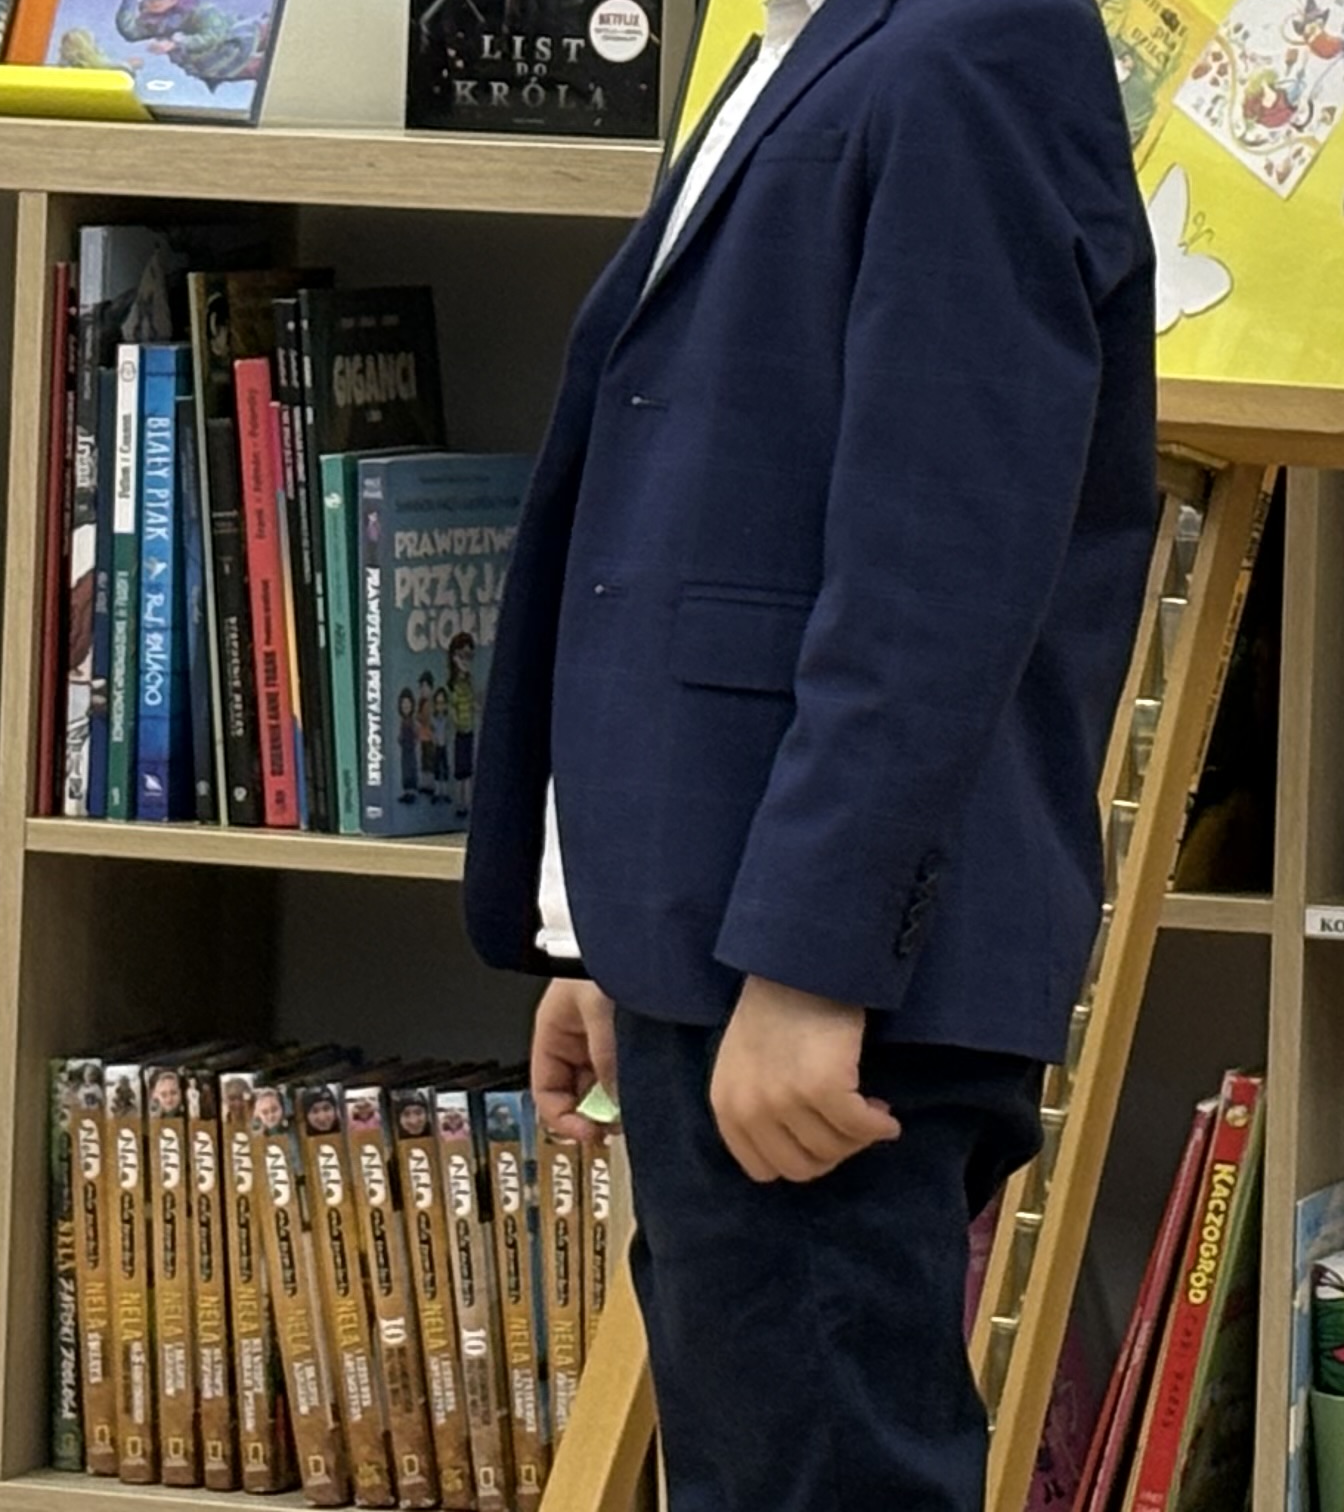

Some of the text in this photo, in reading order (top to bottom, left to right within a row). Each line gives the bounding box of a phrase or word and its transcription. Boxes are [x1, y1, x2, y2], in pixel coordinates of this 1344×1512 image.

[481, 33, 586, 65] LIST
[515, 60, 548, 78] DO
[453, 75, 608, 112] KRÓLA
[144, 416, 169, 481] BIAŁY
[146, 487, 170, 541] PTAK
[394, 526, 520, 559] PRAWDZIW
[365, 566, 382, 666] PRAWDZIWE
[1188, 1161, 1237, 1306] KACZOGRÓD
[380, 1315, 407, 1345] 10
[461, 1326, 488, 1357] 10
